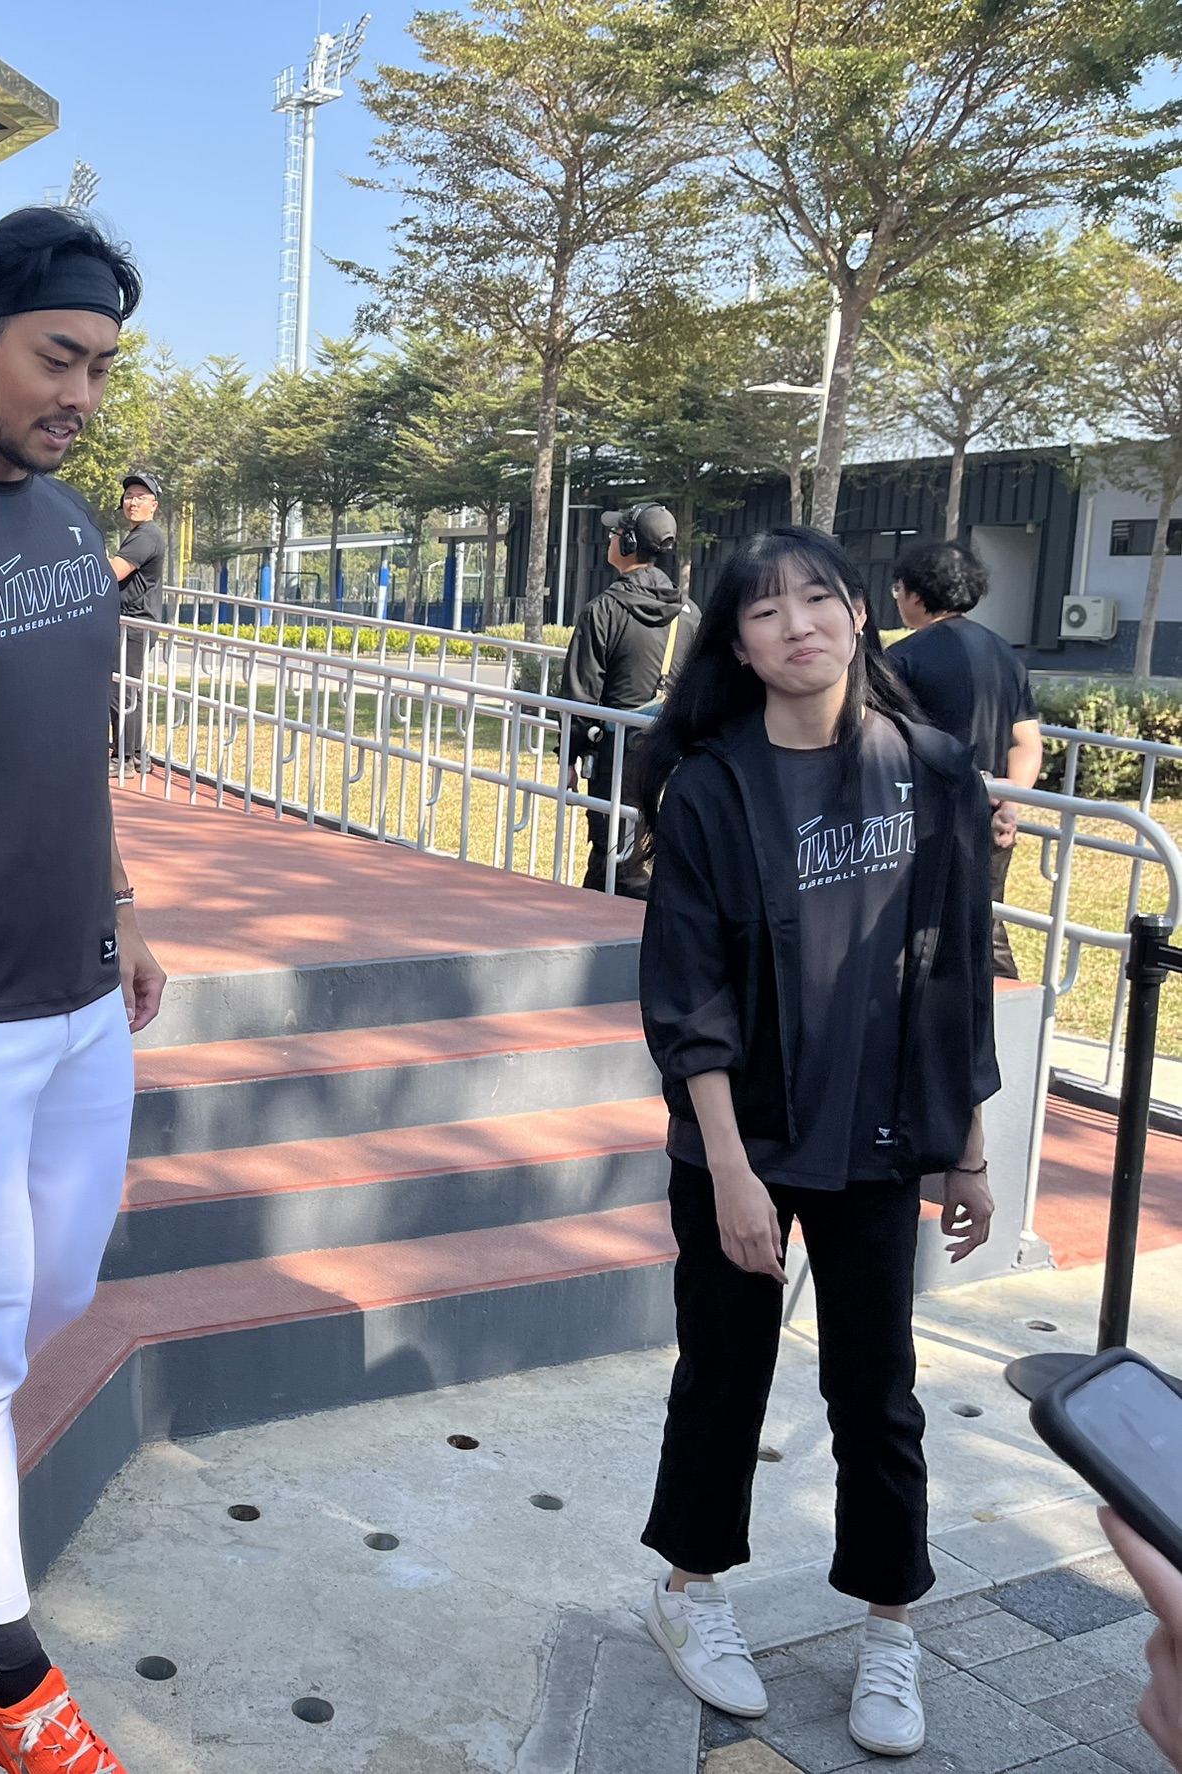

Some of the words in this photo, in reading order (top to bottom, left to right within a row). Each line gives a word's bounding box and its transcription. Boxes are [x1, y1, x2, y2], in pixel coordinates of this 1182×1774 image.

[10, 616, 62, 635] BASEBALL
[66, 605, 93, 620] TEAM
[798, 869, 857, 891] BASEBALL
[863, 860, 899, 874] TEAM
